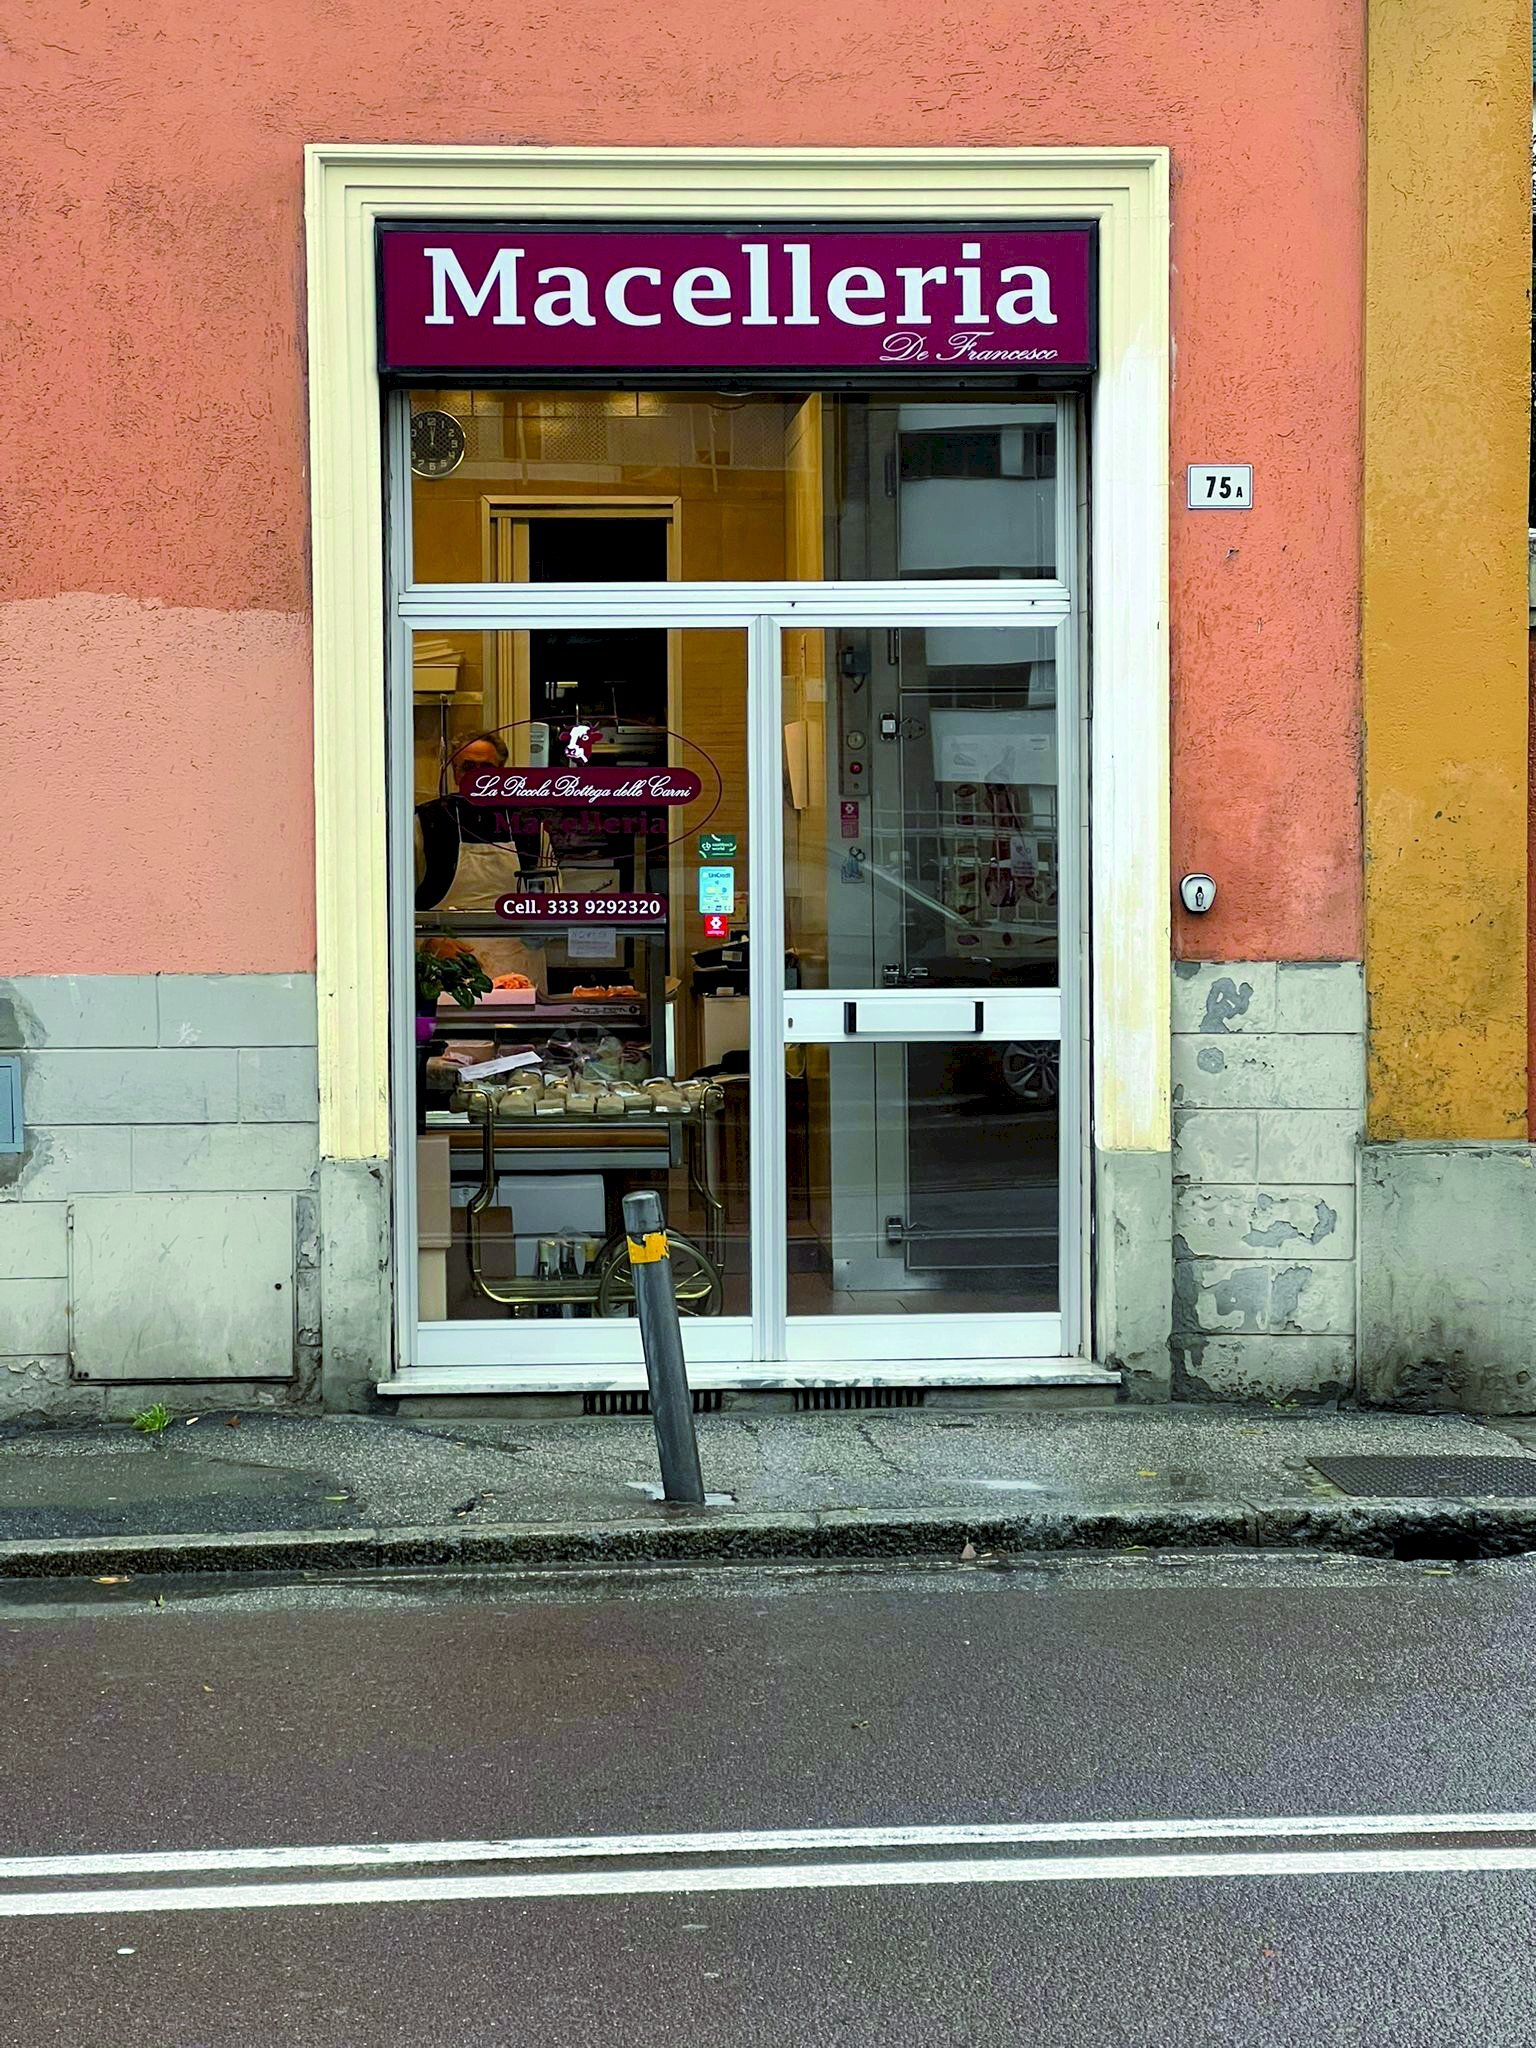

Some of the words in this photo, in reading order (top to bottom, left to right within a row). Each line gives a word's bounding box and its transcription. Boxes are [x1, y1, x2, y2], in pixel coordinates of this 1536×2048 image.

[423, 242, 1058, 327] Macelleria
[879, 331, 929, 361] De
[936, 331, 1059, 361] Francesco
[470, 775, 500, 797] La
[500, 775, 552, 797] Piccola
[552, 775, 611, 803] Bottega
[612, 779, 648, 797] delle
[648, 775, 692, 797] Carni
[493, 810, 668, 834] Macelleria
[503, 899, 542, 915] Cell.
[547, 899, 579, 915] 333
[584, 899, 661, 915] 9292320
